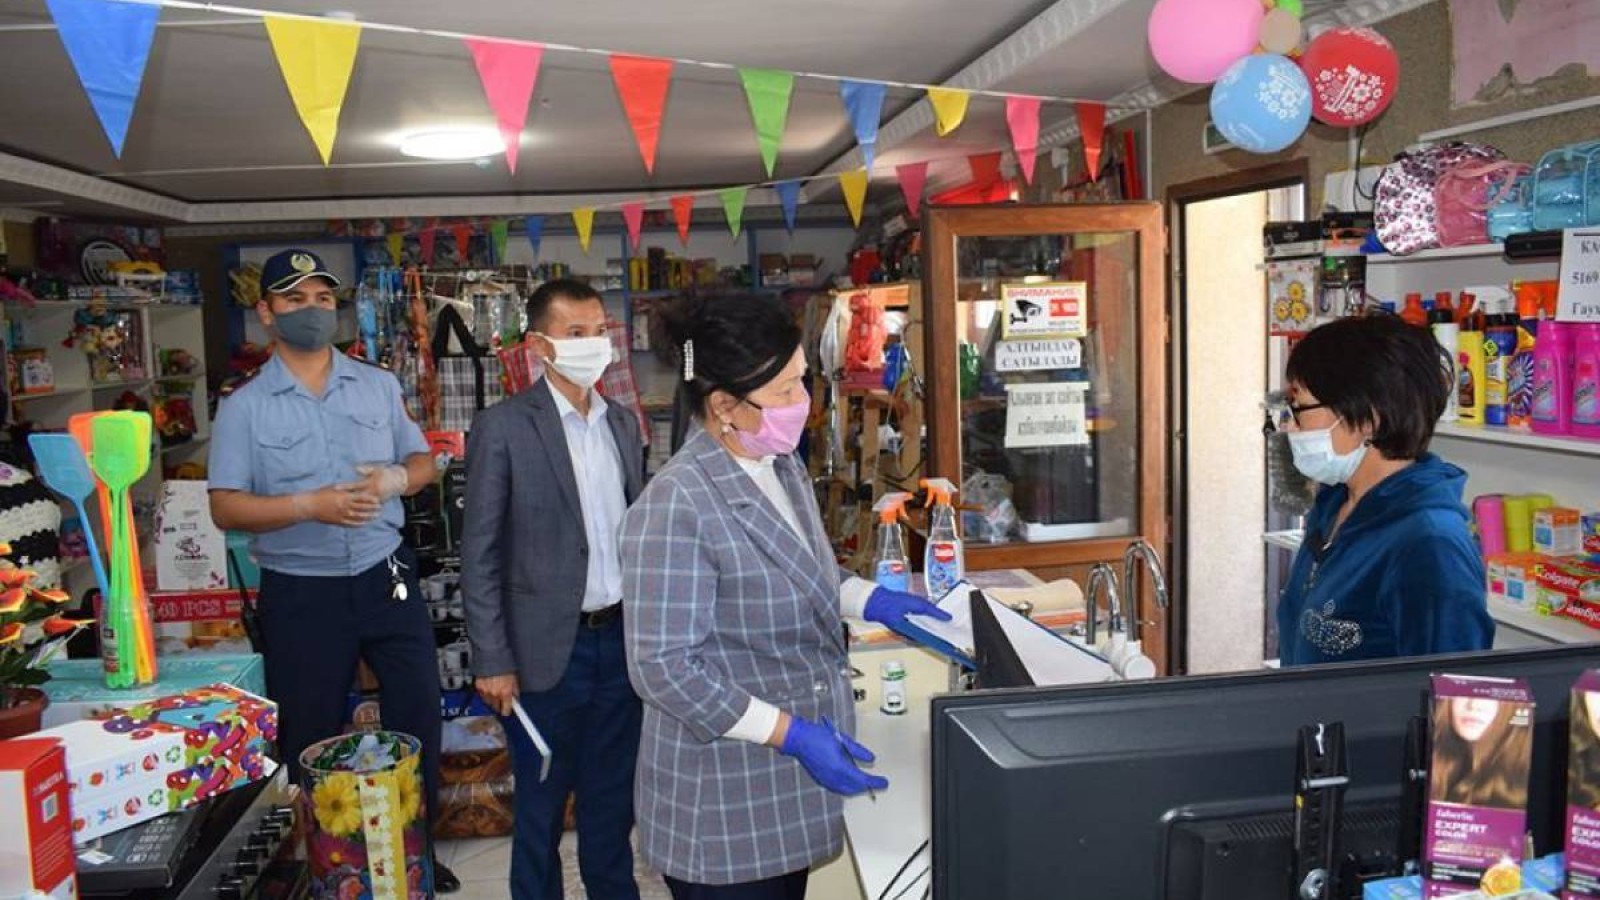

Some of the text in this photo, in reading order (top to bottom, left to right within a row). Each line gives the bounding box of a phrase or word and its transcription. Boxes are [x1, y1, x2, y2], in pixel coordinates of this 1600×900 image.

[1002, 355, 1078, 368] САТЫЛАДЫ
[1542, 570, 1581, 588] Colgate
[1435, 808, 1475, 821] faberlic
[1435, 819, 1489, 834] EXPERT
[1434, 829, 1468, 839] COLOR
